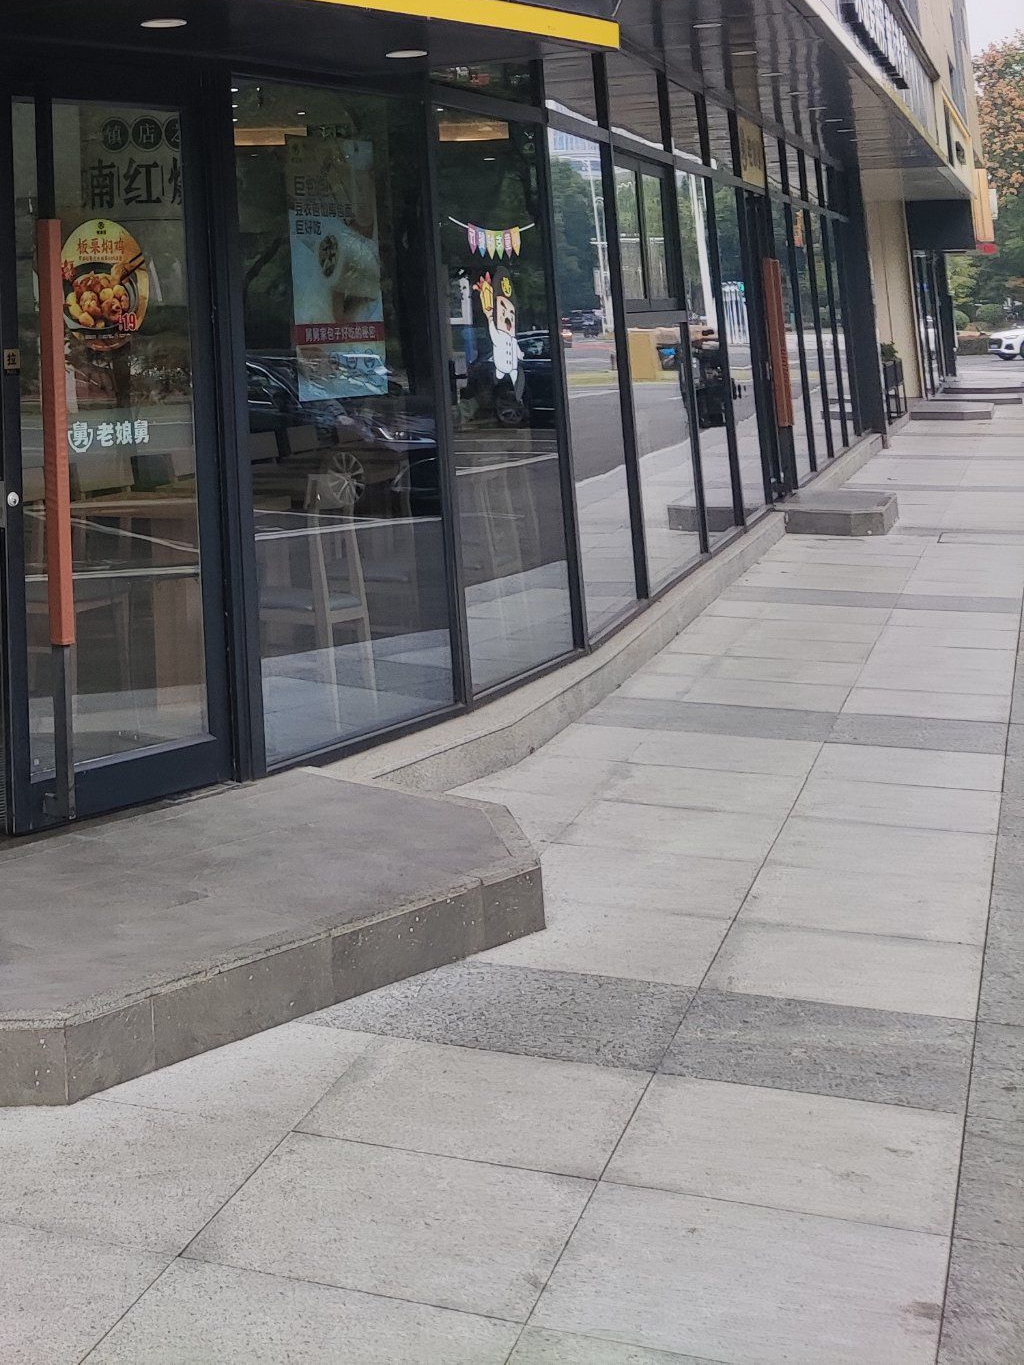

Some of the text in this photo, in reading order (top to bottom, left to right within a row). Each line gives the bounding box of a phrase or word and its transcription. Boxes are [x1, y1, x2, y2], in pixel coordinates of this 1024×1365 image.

[77, 237, 125, 256] 板栗焖鸡
[7, 351, 17, 366] 拉
[96, 420, 150, 447] 老娘舅
